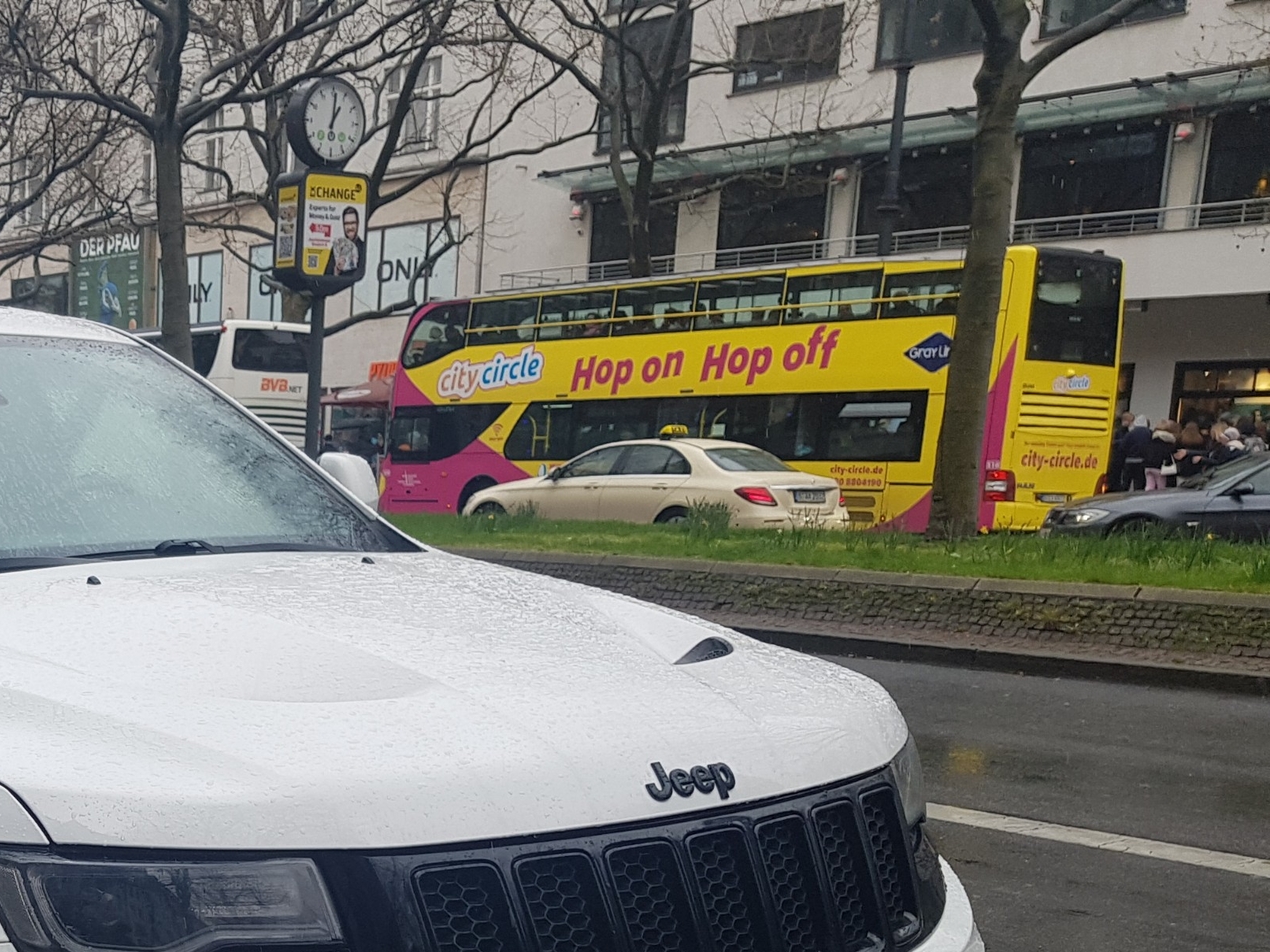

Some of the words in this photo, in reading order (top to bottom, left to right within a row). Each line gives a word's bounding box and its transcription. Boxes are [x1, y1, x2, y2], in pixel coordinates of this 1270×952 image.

[80, 236, 106, 258] DER
[106, 232, 140, 255] PFAU
[570, 355, 634, 395] Hop
[641, 350, 685, 383] on
[699, 341, 773, 386] Hop
[782, 324, 842, 371] off
[830, 464, 883, 475] city-circle.de
[1021, 449, 1098, 471] city-circle.de
[645, 761, 736, 802] Jeep
